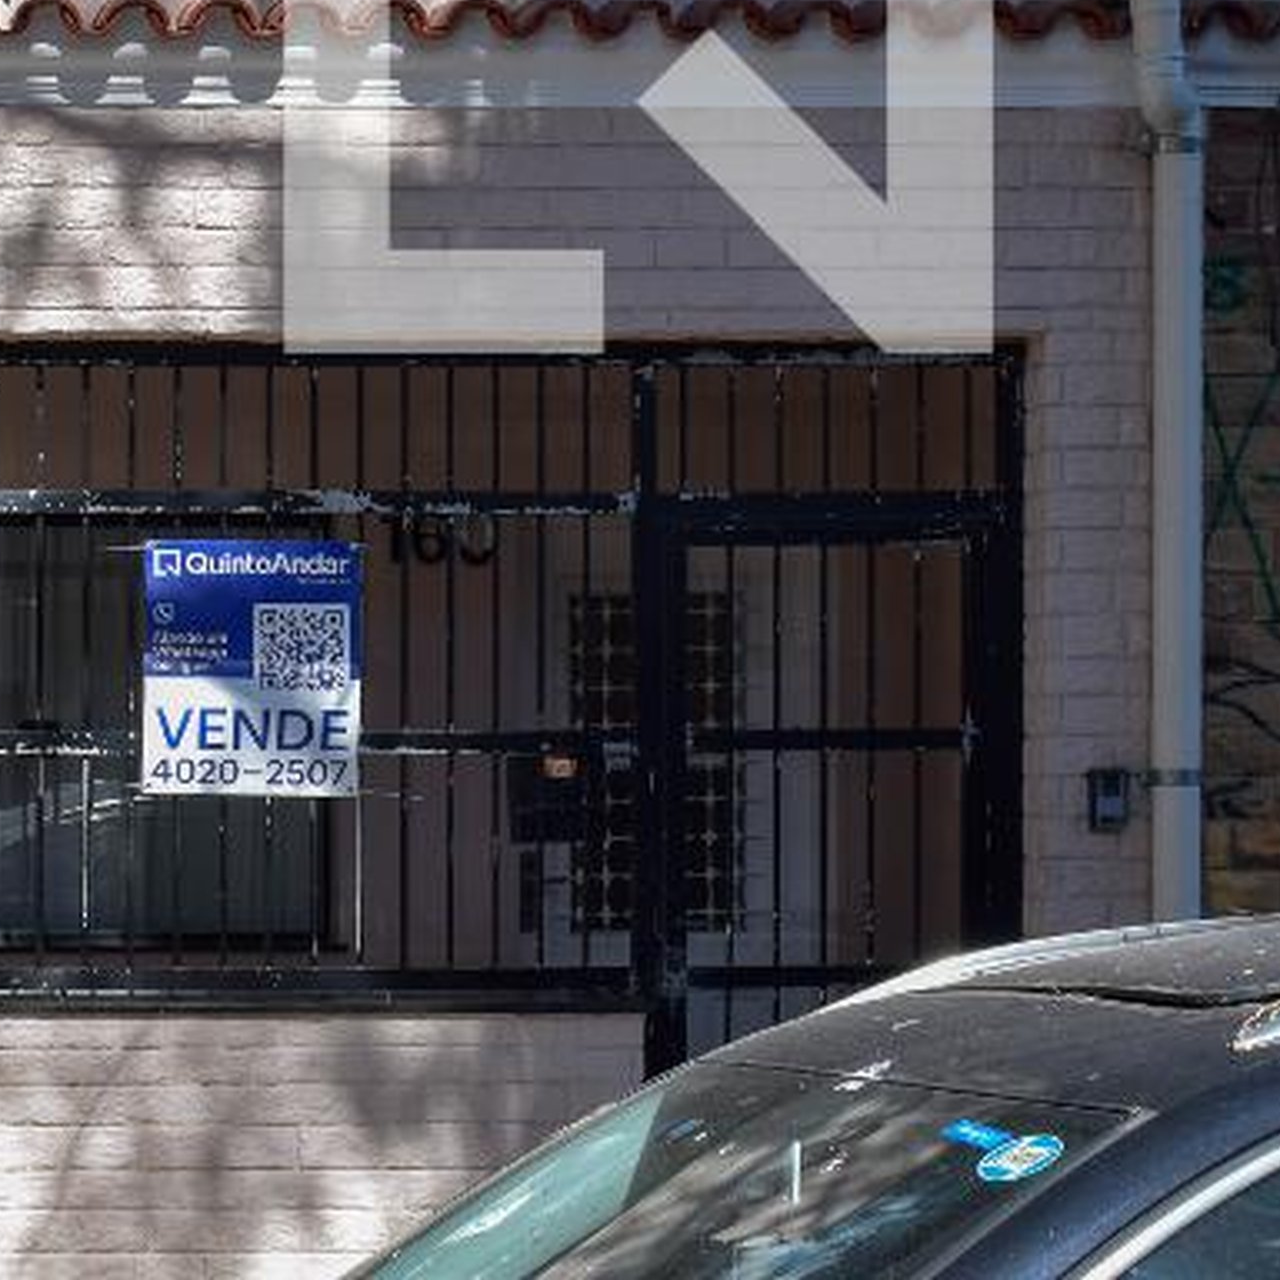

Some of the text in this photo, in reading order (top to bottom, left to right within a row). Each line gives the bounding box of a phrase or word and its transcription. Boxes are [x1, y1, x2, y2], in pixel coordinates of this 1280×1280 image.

[185, 552, 350, 574] QuintoAndar
[156, 707, 350, 751] VENDE
[151, 758, 349, 786] 4020-2507
